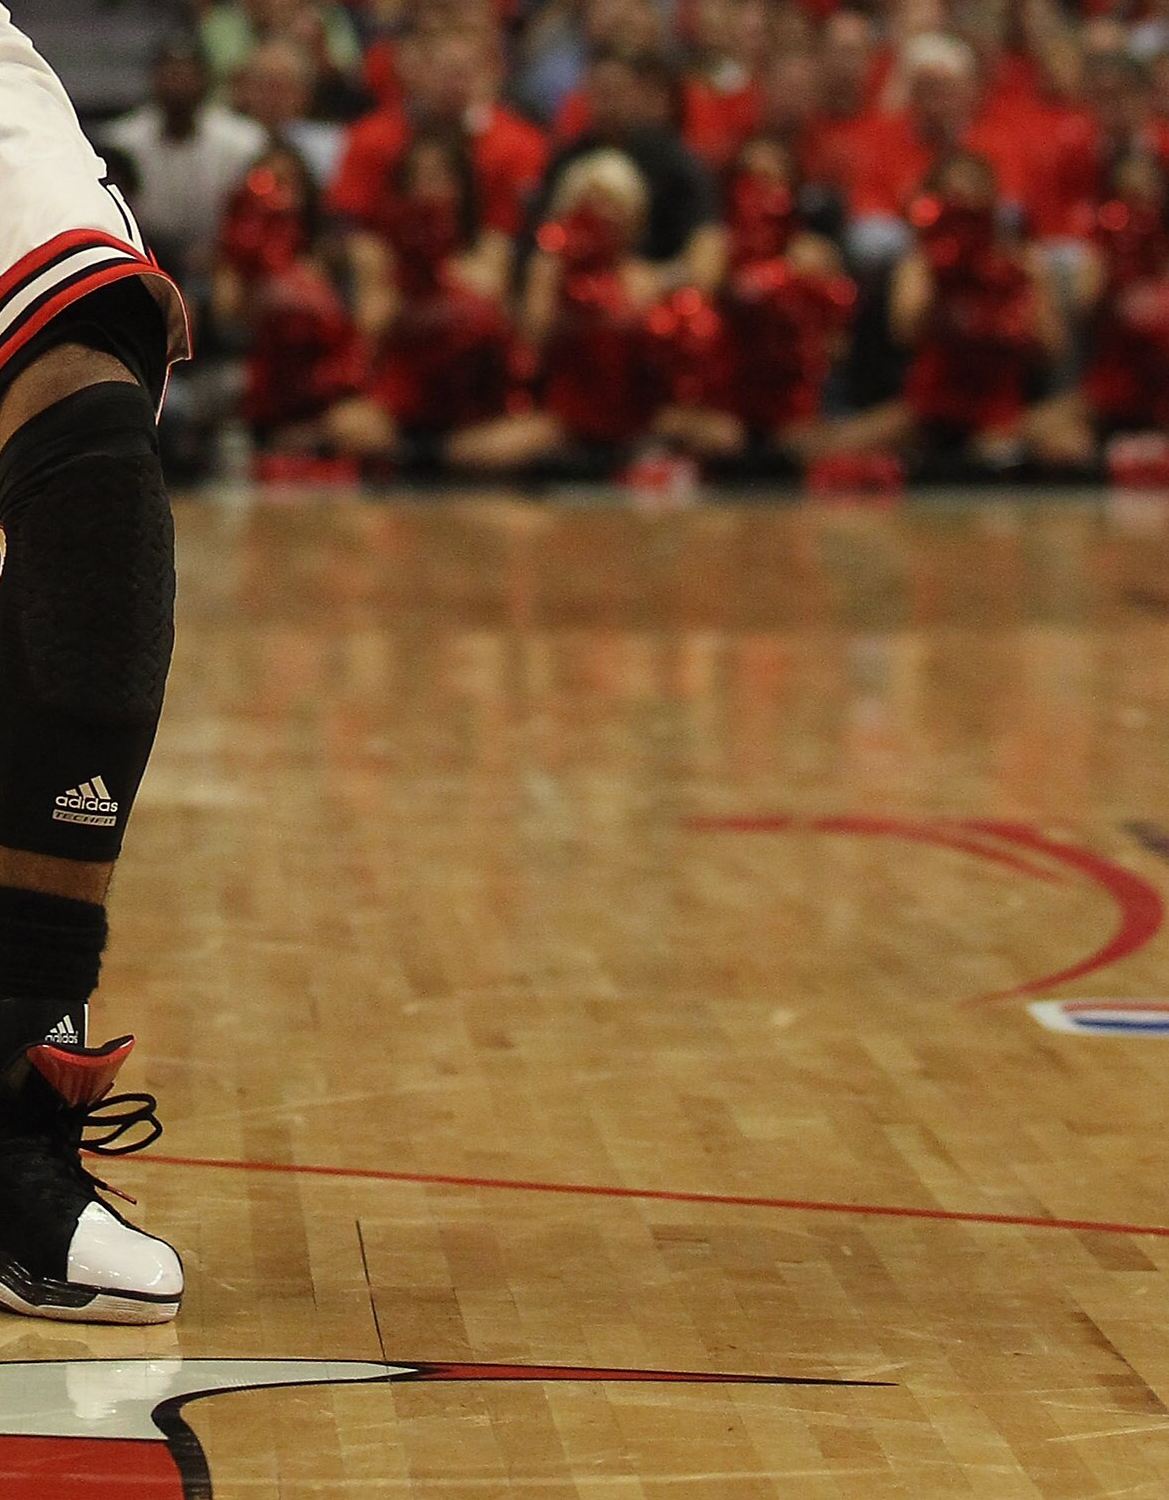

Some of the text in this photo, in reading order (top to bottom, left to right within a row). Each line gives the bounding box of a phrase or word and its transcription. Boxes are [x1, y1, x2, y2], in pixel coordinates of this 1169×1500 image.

[55, 795, 119, 813] adidas
[54, 811, 115, 825] TECHFIT
[45, 1032, 78, 1044] adidas
